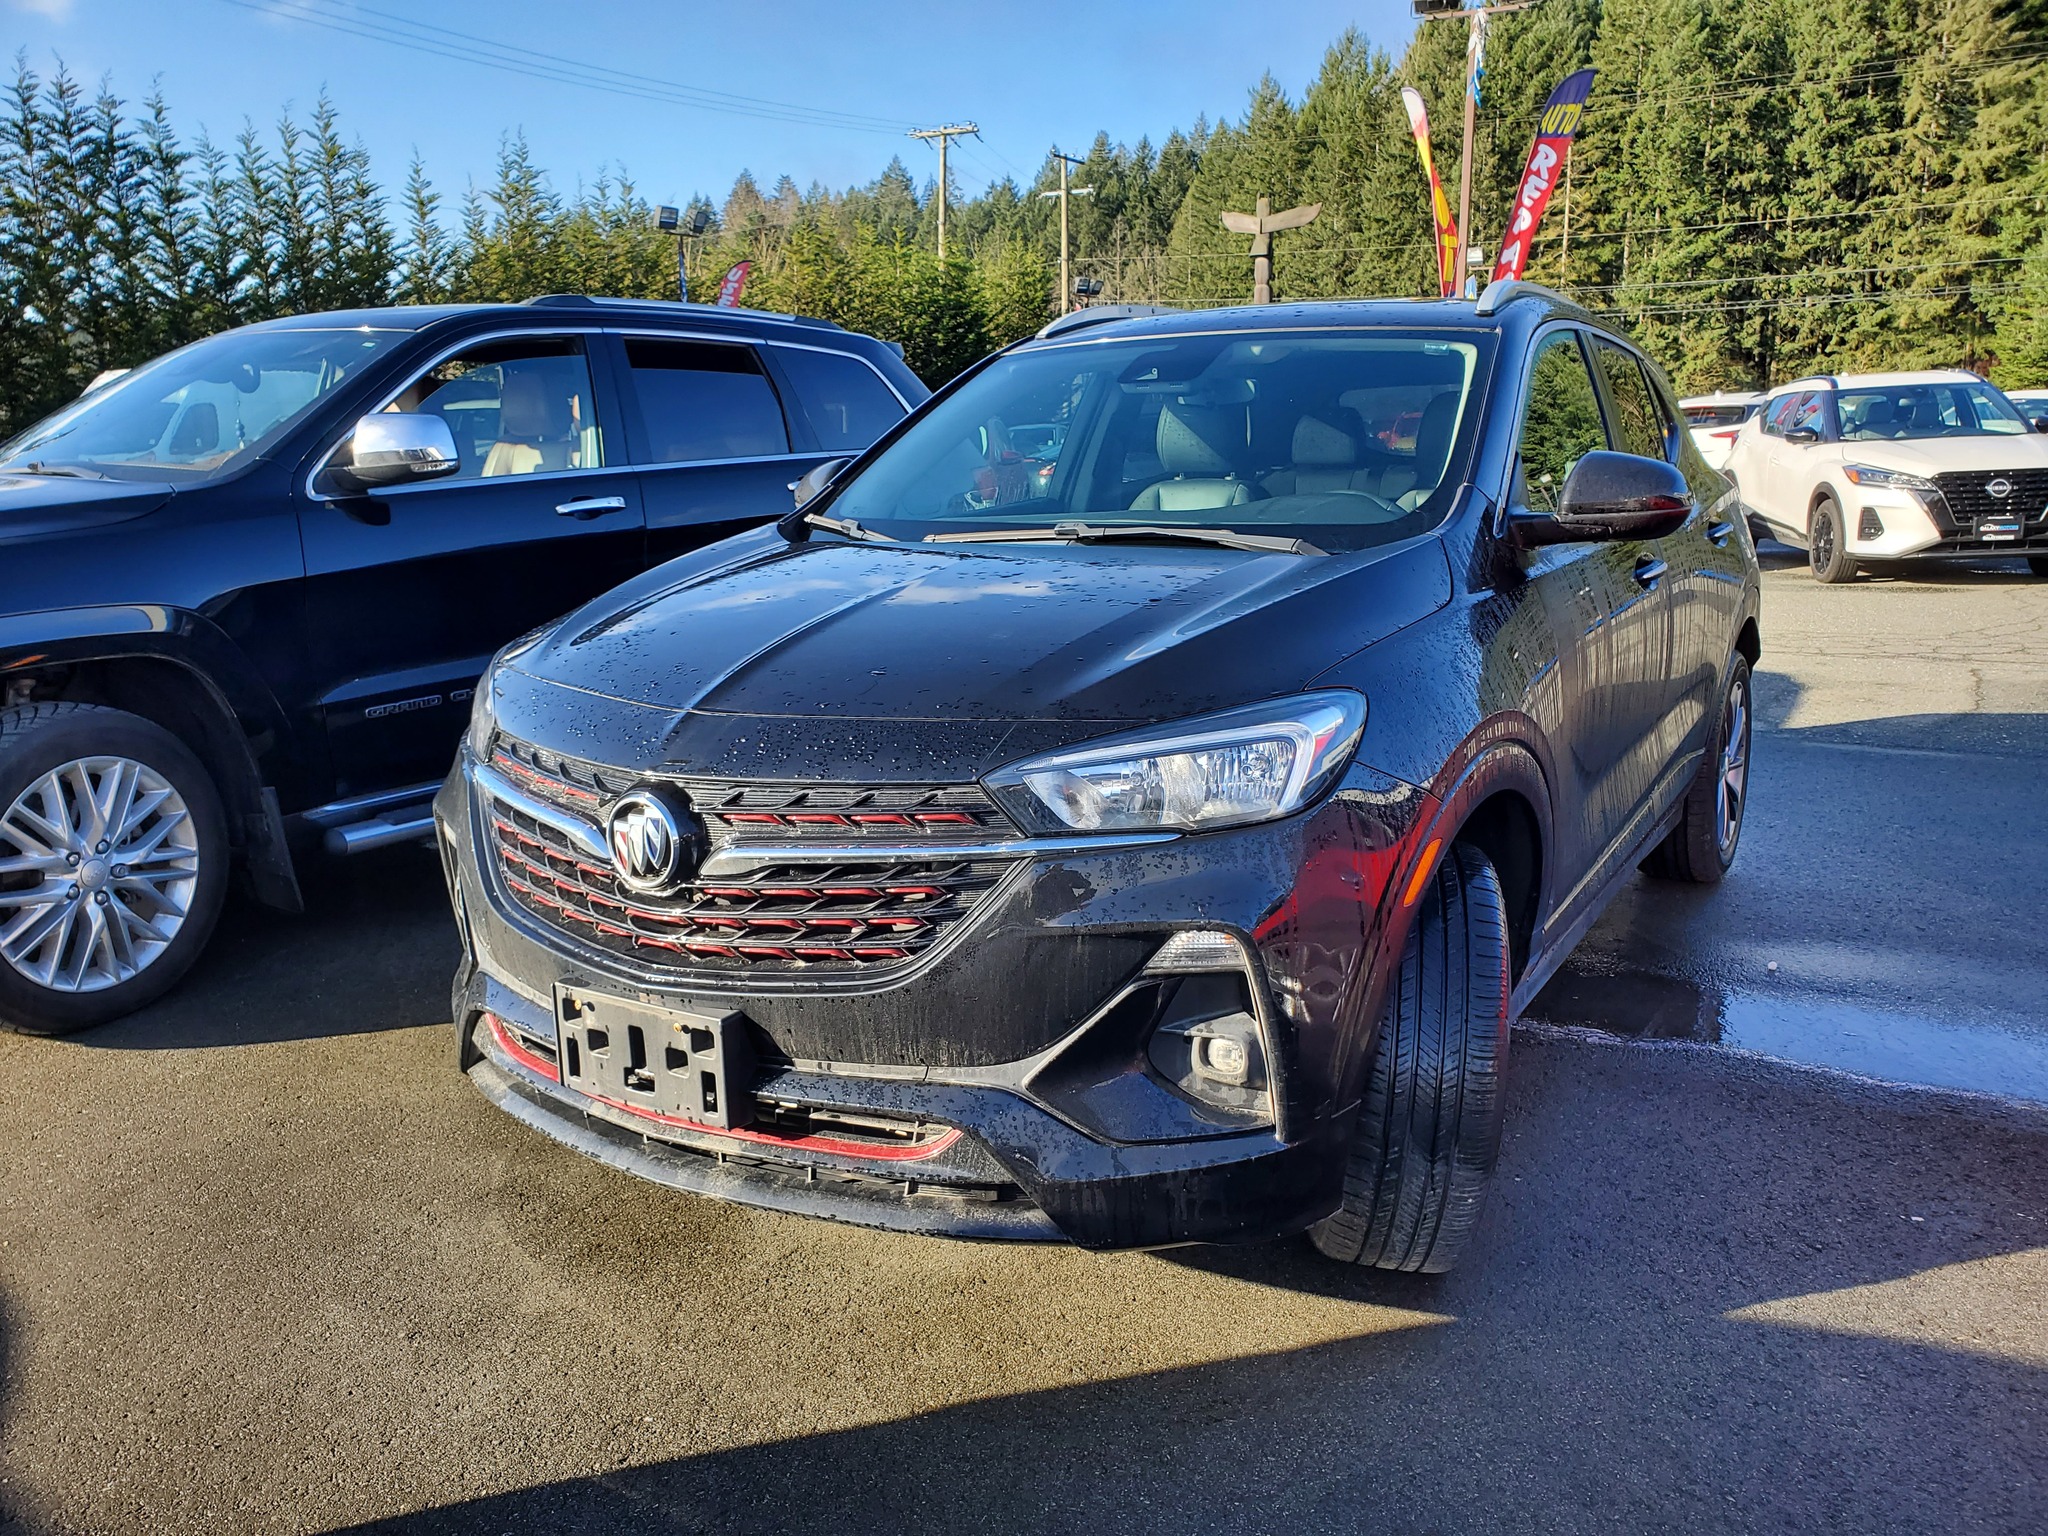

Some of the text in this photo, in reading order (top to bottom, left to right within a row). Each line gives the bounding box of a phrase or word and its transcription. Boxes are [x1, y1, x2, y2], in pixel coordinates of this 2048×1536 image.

[1541, 103, 1583, 135] AUTO
[1500, 143, 1557, 281] REPA
[365, 695, 442, 718] GRAND
